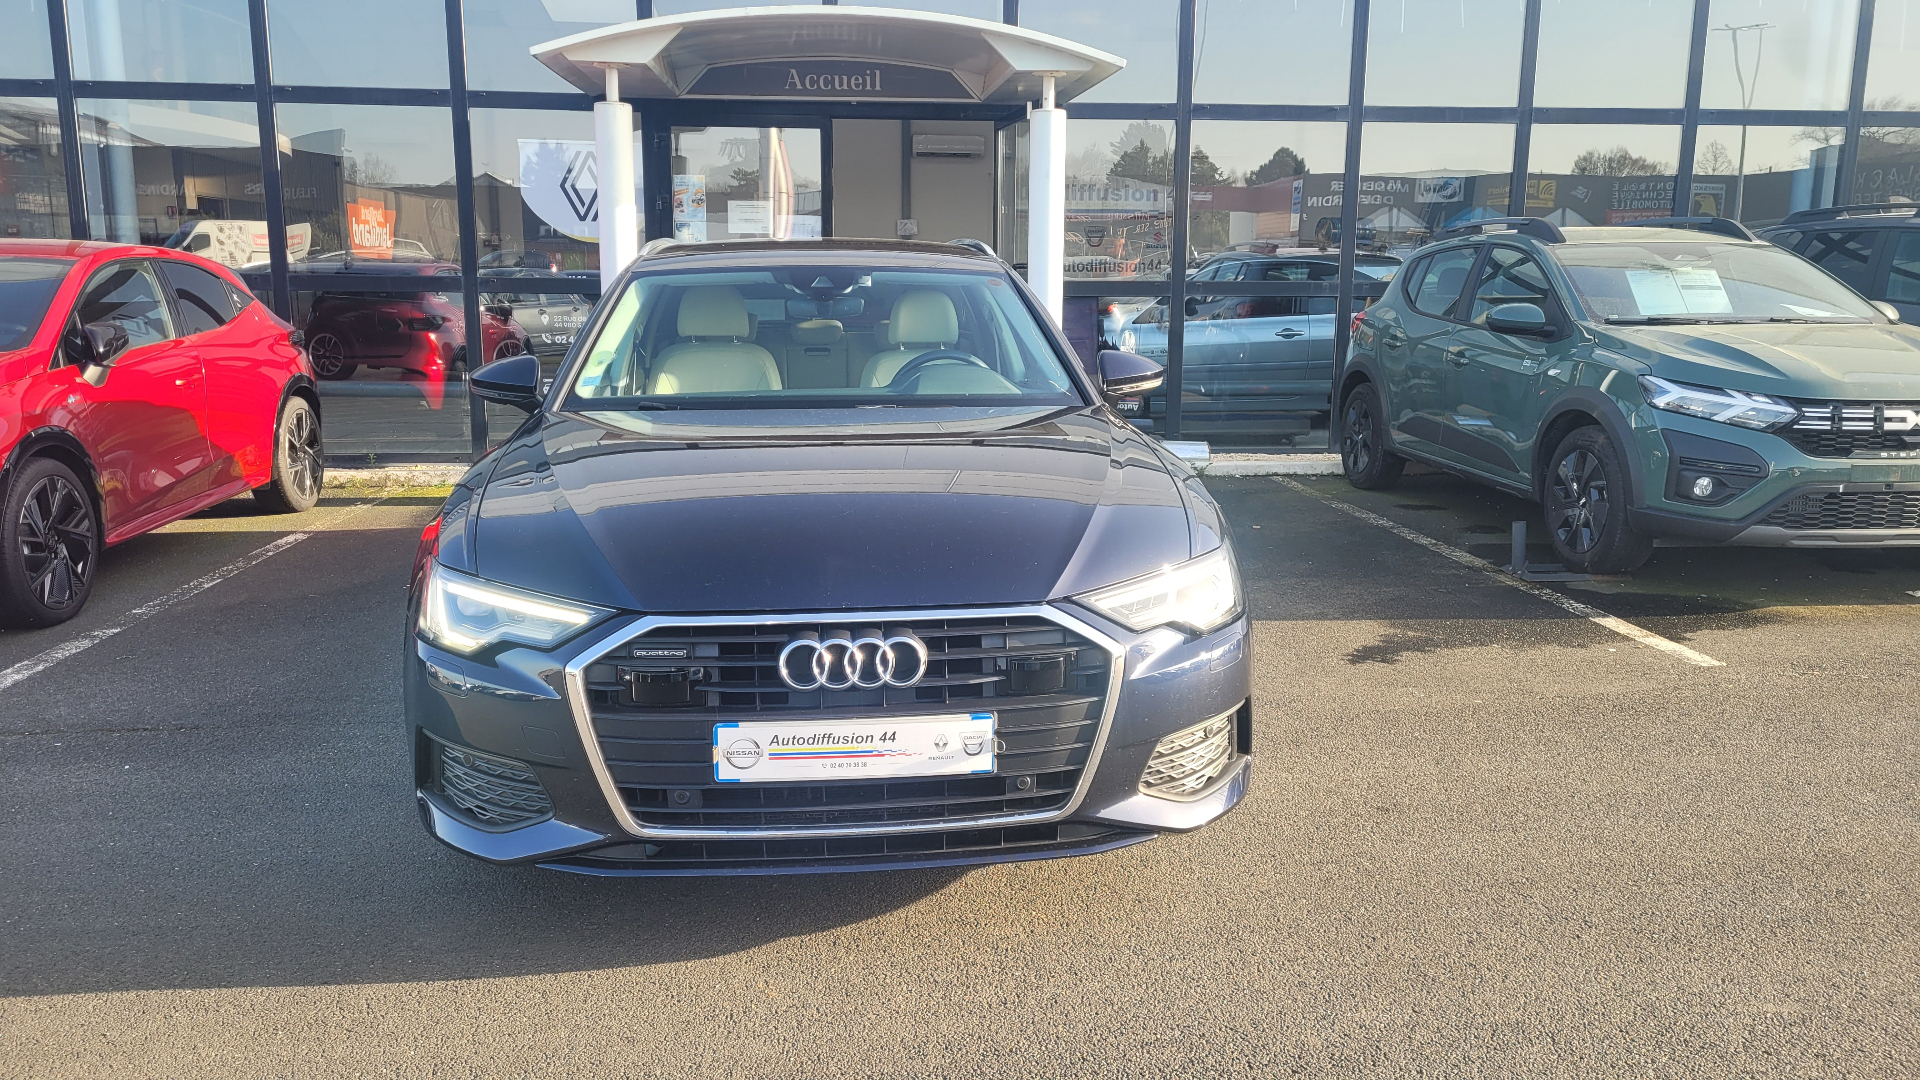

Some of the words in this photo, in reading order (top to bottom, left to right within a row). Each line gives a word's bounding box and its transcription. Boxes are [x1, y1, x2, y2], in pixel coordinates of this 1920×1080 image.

[784, 68, 882, 91] Accueil
[555, 335, 567, 343] 02
[768, 732, 875, 747] Autodiffusion
[878, 731, 897, 744] 44
